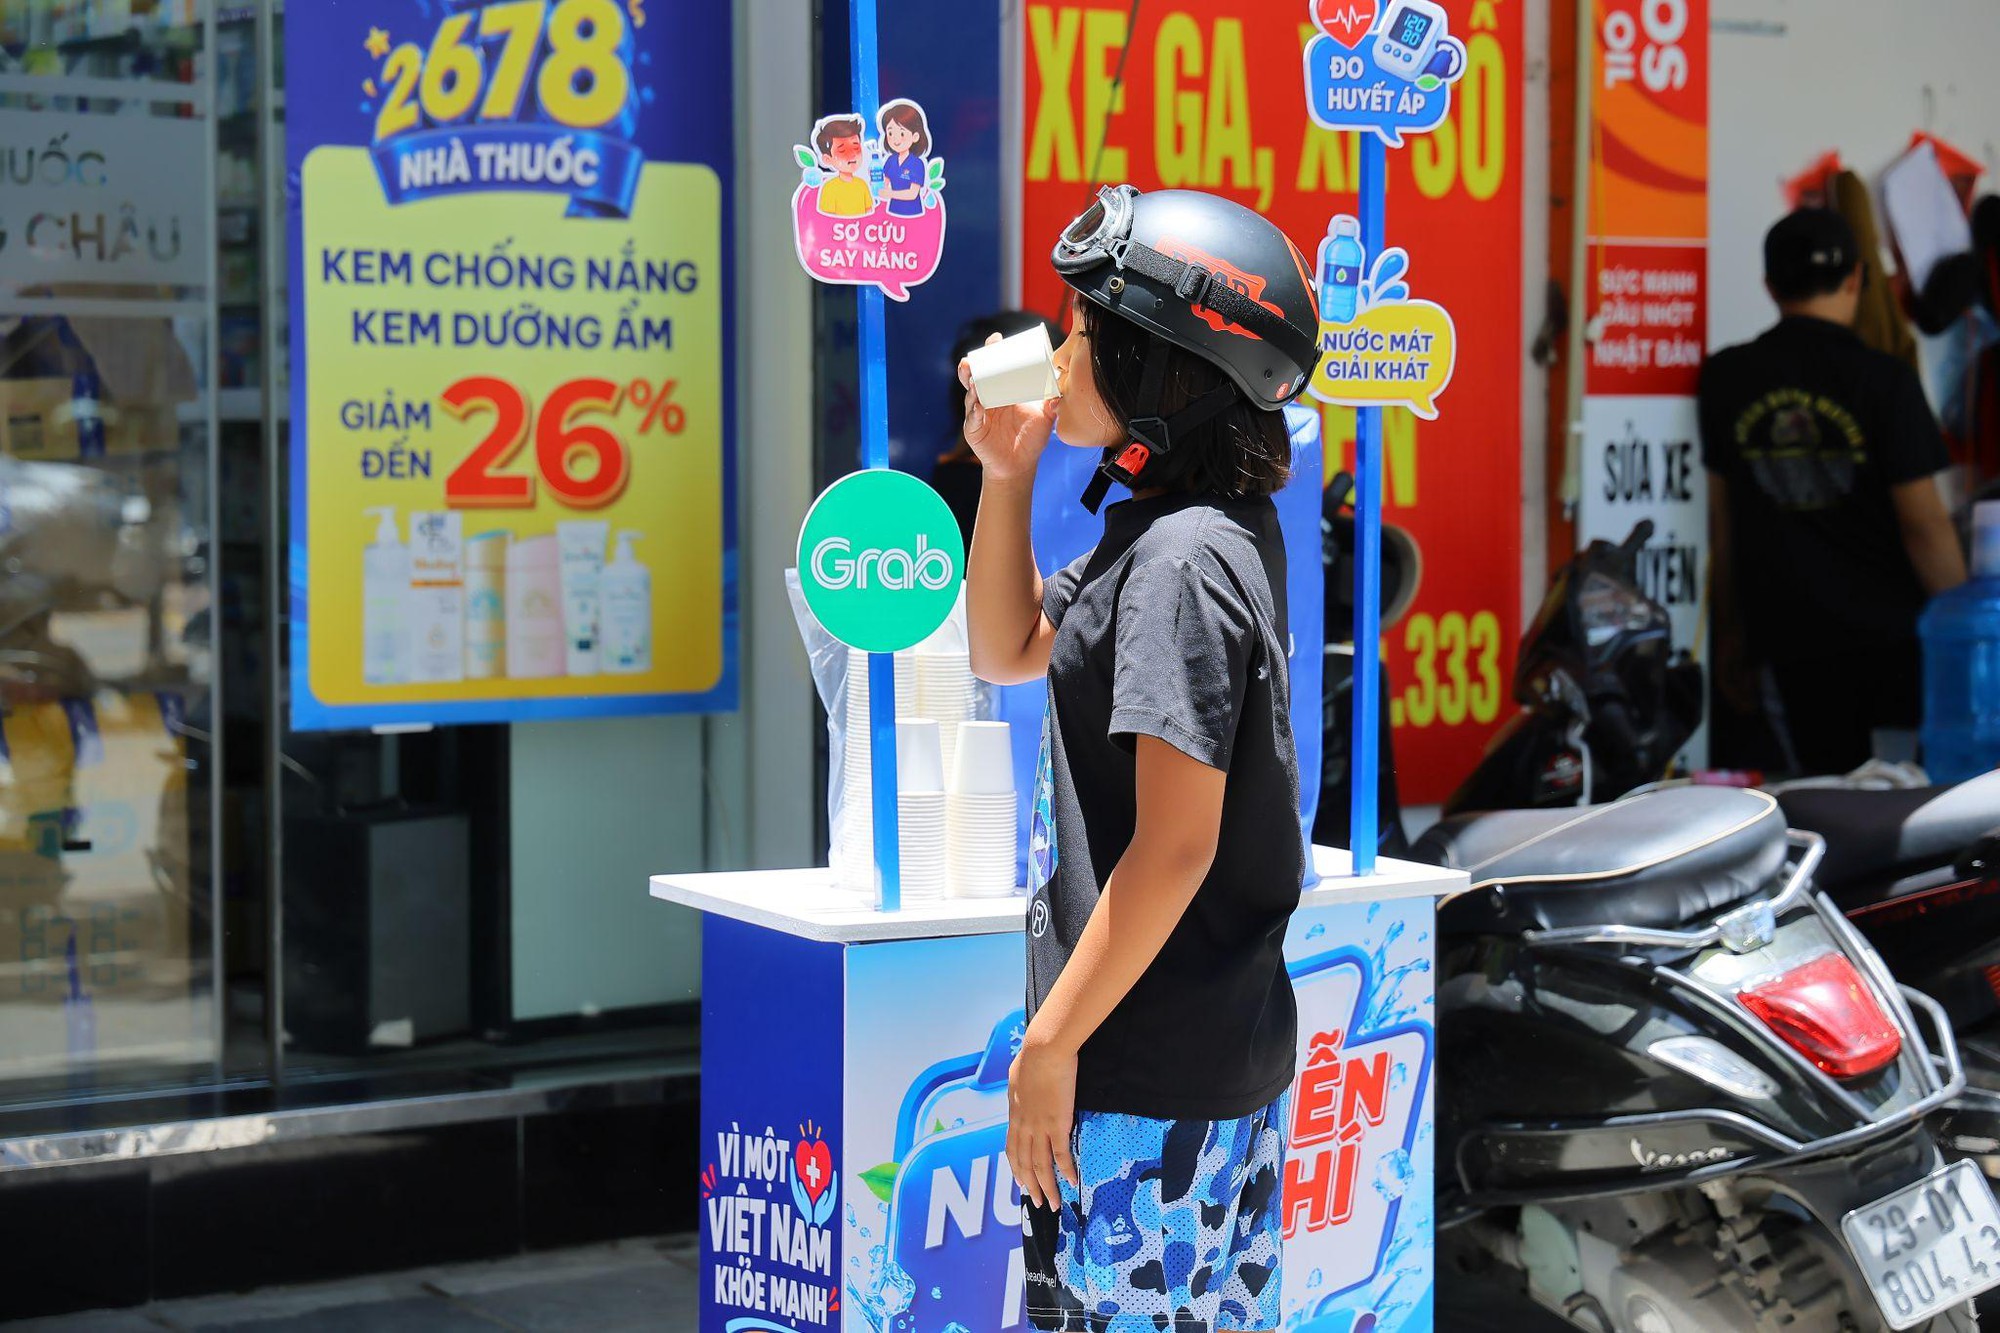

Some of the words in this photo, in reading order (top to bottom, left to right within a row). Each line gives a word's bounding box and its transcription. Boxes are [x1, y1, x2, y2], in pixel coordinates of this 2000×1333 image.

[1401, 29, 1419, 47] 80
[1404, 13, 1428, 33] 120
[375, 0, 628, 140] 2678
[1329, 55, 1364, 80] ĐO
[1603, 11, 1636, 90] OIL
[1026, 4, 1129, 184] XE
[1154, 12, 1275, 212] GA,
[1328, 81, 1395, 113] HUYẾT
[1397, 86, 1426, 115] ÁP
[400, 138, 471, 189] NHÀ
[474, 137, 600, 186] THUỐC
[820, 249, 858, 268] SAY
[862, 245, 919, 270] NẮNG
[832, 221, 861, 242] SƠ
[864, 221, 906, 244] CỨU
[322, 248, 412, 284] KEM
[425, 237, 575, 290] CHỐNG
[586, 238, 699, 293] NẮNG
[352, 310, 441, 347] KEM
[453, 303, 600, 349] DƯỠNG
[613, 298, 672, 351] ẨM
[1323, 328, 1384, 352] NƯỚC
[1389, 329, 1433, 352] MÁT
[1326, 355, 1369, 380] GIẢI
[1374, 358, 1429, 380] KHÁT
[341, 389, 432, 430] GIẢM
[361, 436, 432, 479] ĐẾN
[1662, 442, 1693, 501] XE
[810, 534, 954, 590] Grab
[718, 1121, 740, 1177] VÌ
[744, 1126, 790, 1193] MỘT
[708, 1182, 766, 1266] VIỆT
[770, 1202, 832, 1277] NAM
[1868, 1178, 1974, 1262] 29-01
[715, 1255, 766, 1311] KHỎE
[770, 1275, 828, 1328] MẠNH
